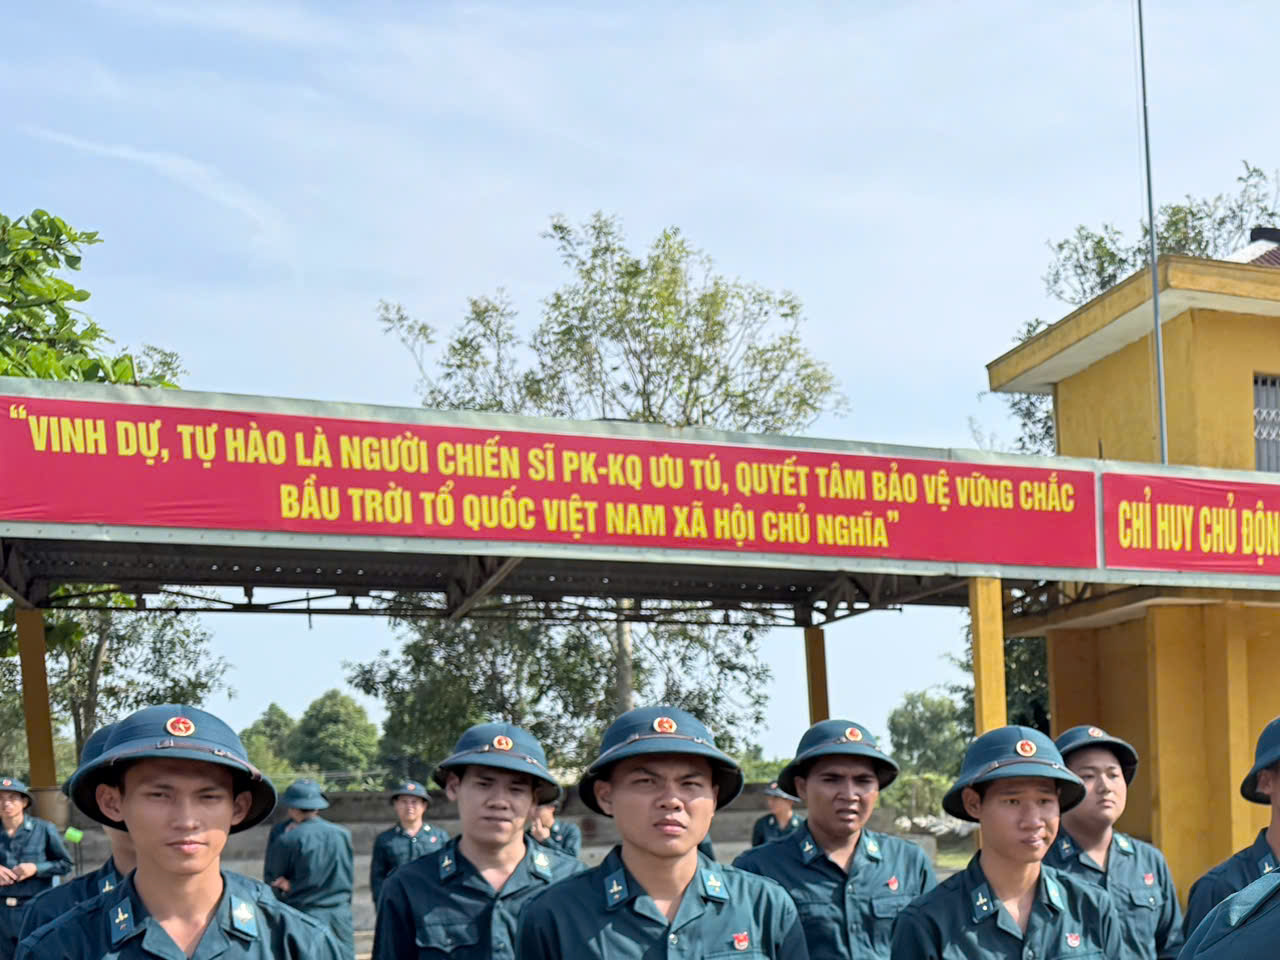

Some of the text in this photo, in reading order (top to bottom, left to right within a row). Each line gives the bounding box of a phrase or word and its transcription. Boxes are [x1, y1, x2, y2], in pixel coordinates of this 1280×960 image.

[116, 420, 169, 465] DỰ,
[177, 424, 218, 468] TỰ
[225, 423, 286, 465] HÀO
[296, 427, 332, 468] LÀ
[340, 432, 429, 473] NGƯỜI
[437, 436, 520, 478] CHIẾN
[528, 444, 555, 481] SĨ
[562, 451, 642, 490] PK-KQ
[650, 455, 684, 489] ƯU
[690, 455, 728, 495] TÚ,
[736, 456, 809, 496] QUYẾT
[815, 464, 866, 500] TÂM
[872, 460, 917, 503] BẢO
[923, 469, 950, 511] VỆ
[956, 472, 1013, 508] VỮNG
[1019, 472, 1075, 512] CHẮC
[347, 483, 413, 524] TRỜI
[419, 480, 454, 526] TỔ
[463, 486, 536, 531] QUỐC
[544, 494, 598, 539] VIỆT
[606, 502, 666, 536] NAM
[673, 501, 708, 538] XÃ
[714, 504, 755, 547] HỘI
[762, 504, 810, 544] CHỦ
[1118, 486, 1152, 549] CHỈ
[1157, 504, 1194, 551] HUY
[1199, 492, 1237, 554] CHỦ
